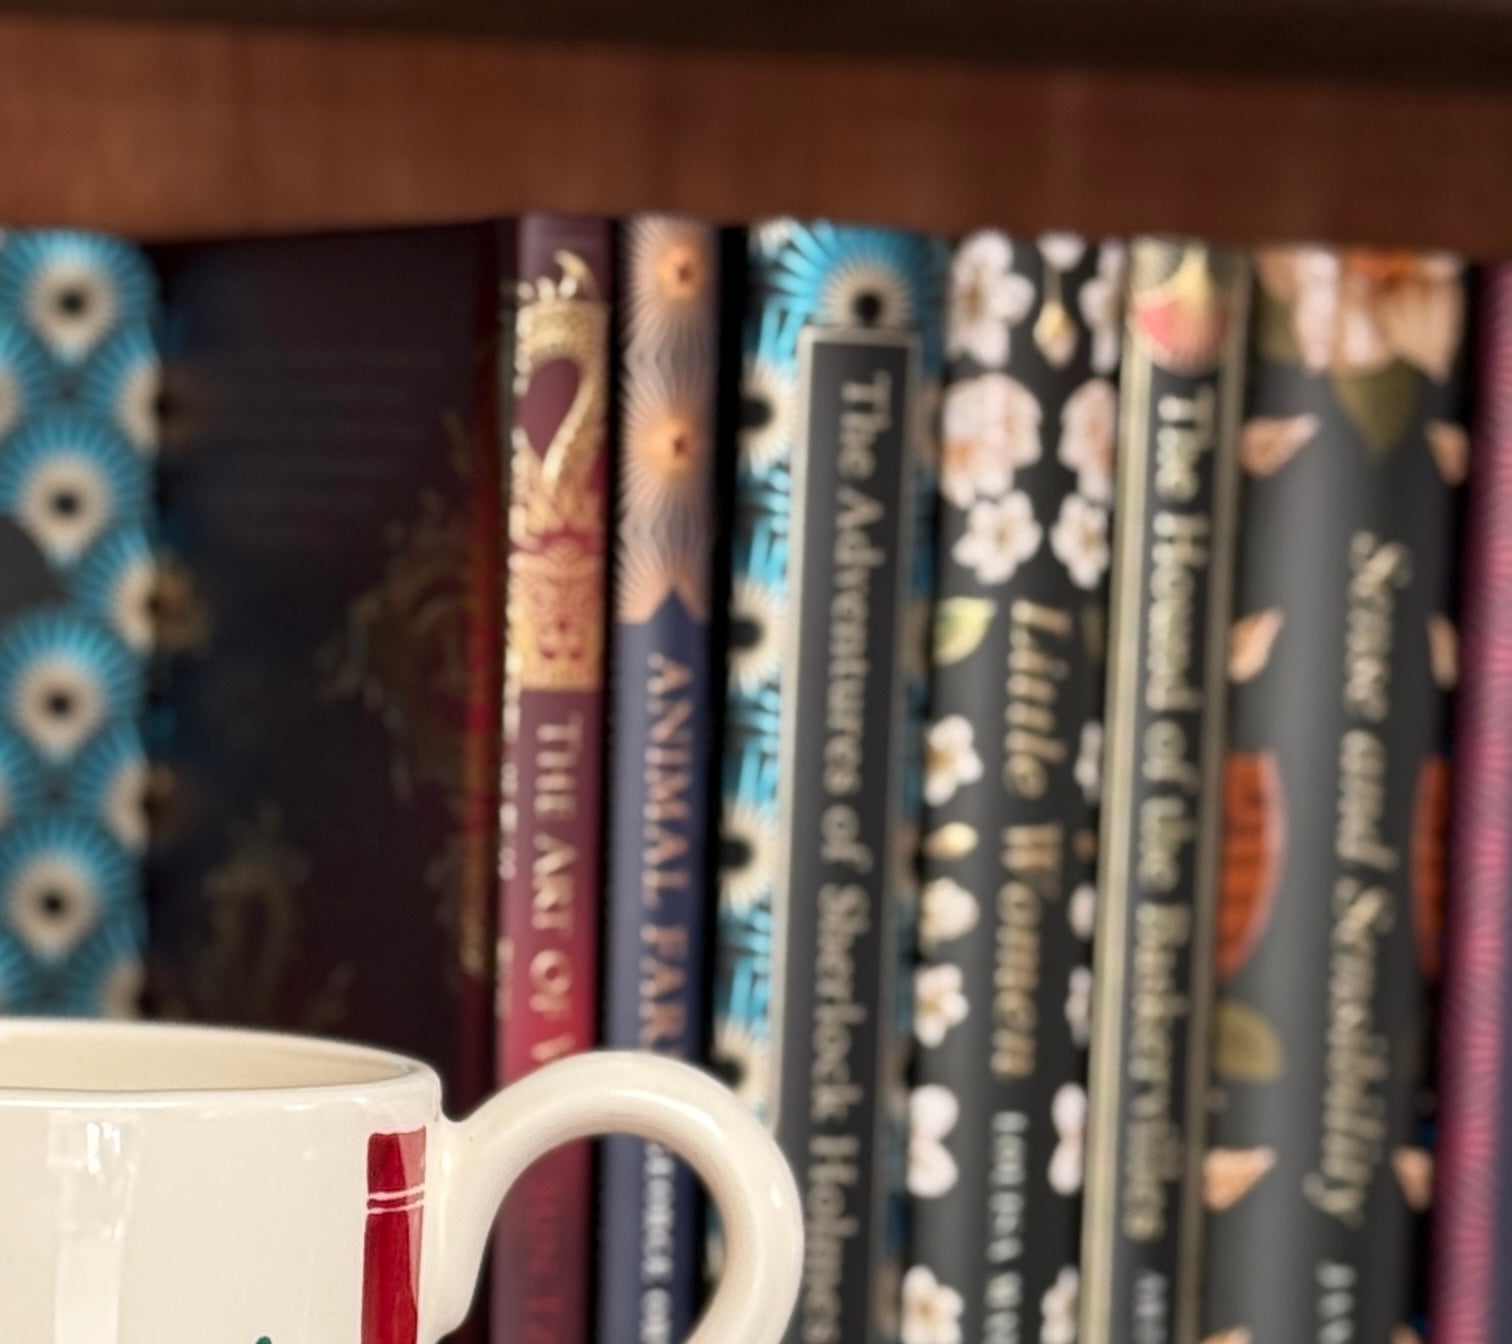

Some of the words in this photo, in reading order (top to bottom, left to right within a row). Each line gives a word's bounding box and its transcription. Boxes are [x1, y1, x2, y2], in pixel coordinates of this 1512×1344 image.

[837, 369, 892, 481] The
[1154, 385, 1215, 502] The
[822, 486, 886, 797] Adventures
[1145, 511, 1211, 712] Hound
[1003, 599, 1074, 799] Little
[1142, 720, 1201, 791] of
[533, 712, 583, 819] THE
[641, 652, 696, 908] ANIMAL
[531, 832, 577, 937] ART
[820, 803, 874, 874] of
[529, 949, 573, 1024] OF
[638, 922, 688, 1054] FAR
[810, 882, 870, 1123] Sherlock
[990, 822, 1065, 1080] Women
